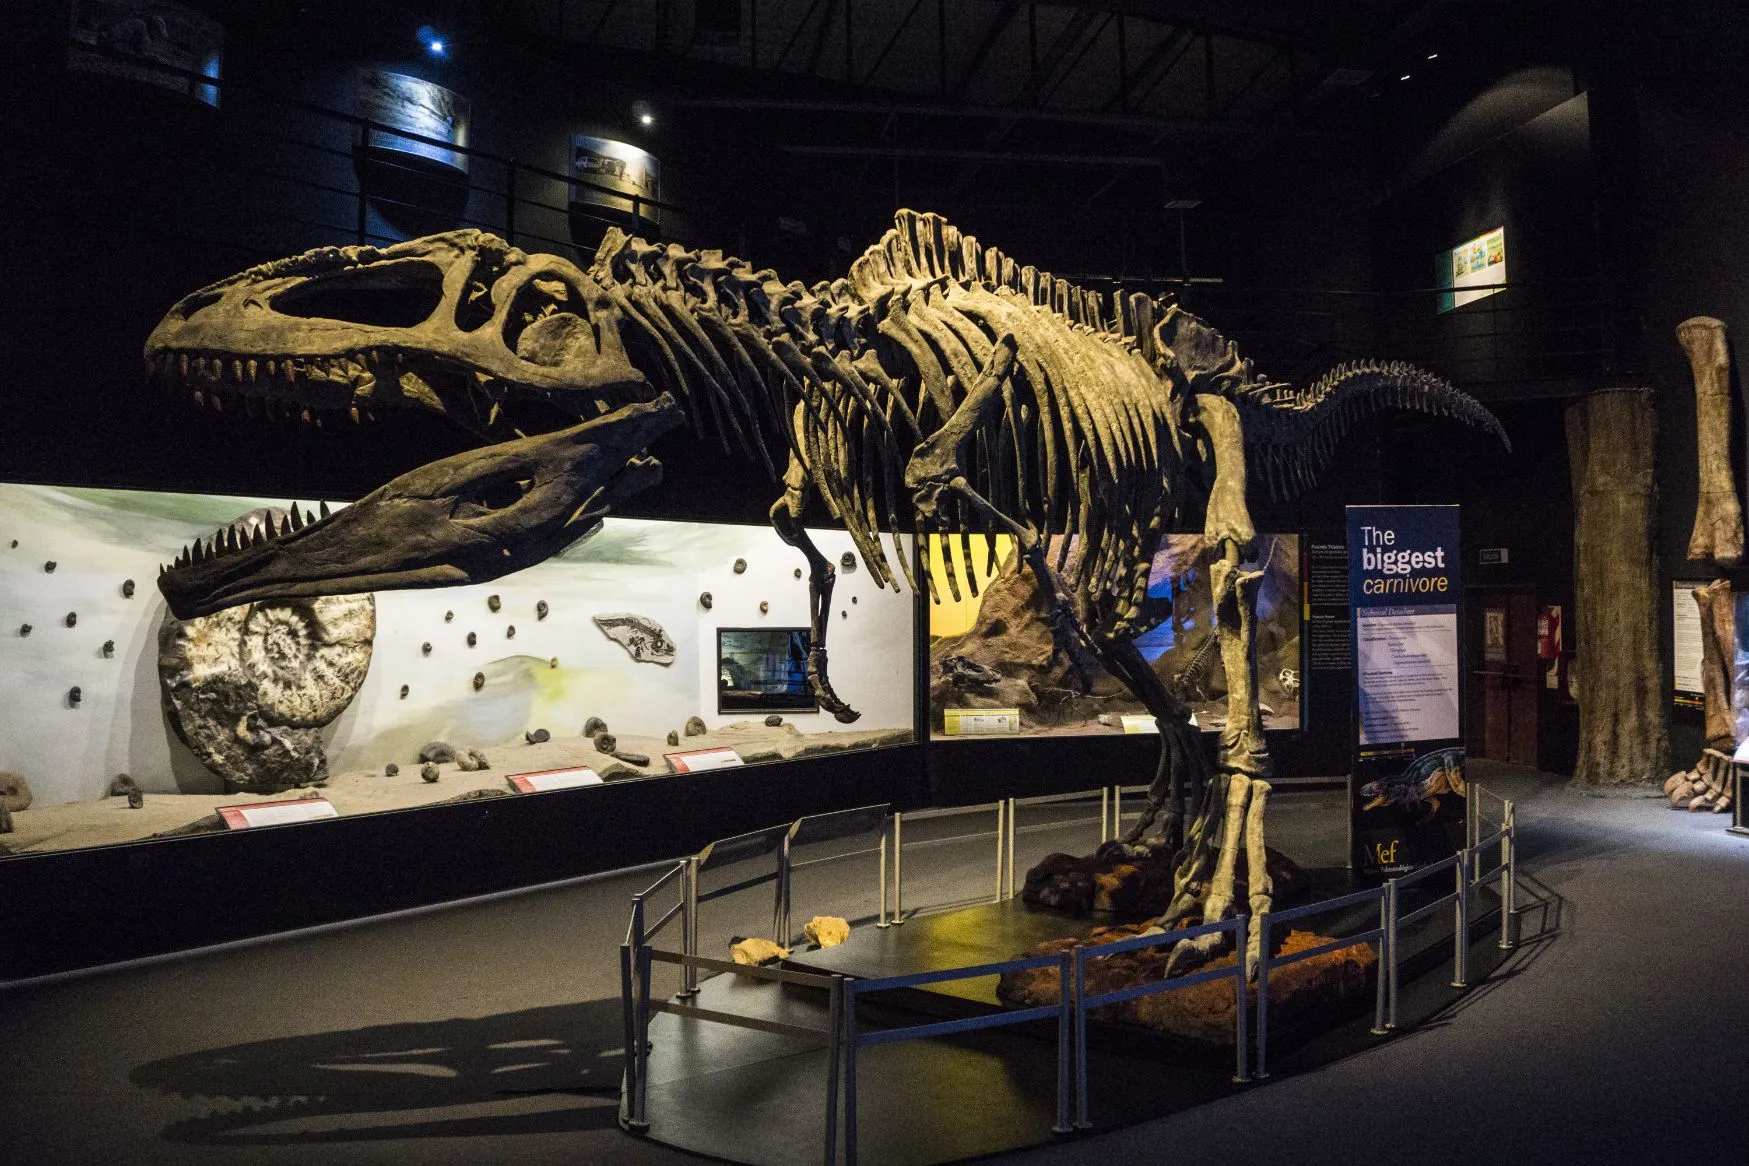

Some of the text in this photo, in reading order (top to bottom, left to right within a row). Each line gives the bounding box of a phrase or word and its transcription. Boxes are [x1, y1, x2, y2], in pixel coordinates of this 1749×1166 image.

[1360, 526, 1395, 546] The
[1362, 546, 1445, 575] biggest
[1363, 574, 1448, 595] carnivore
[1363, 840, 1399, 865] Mef
